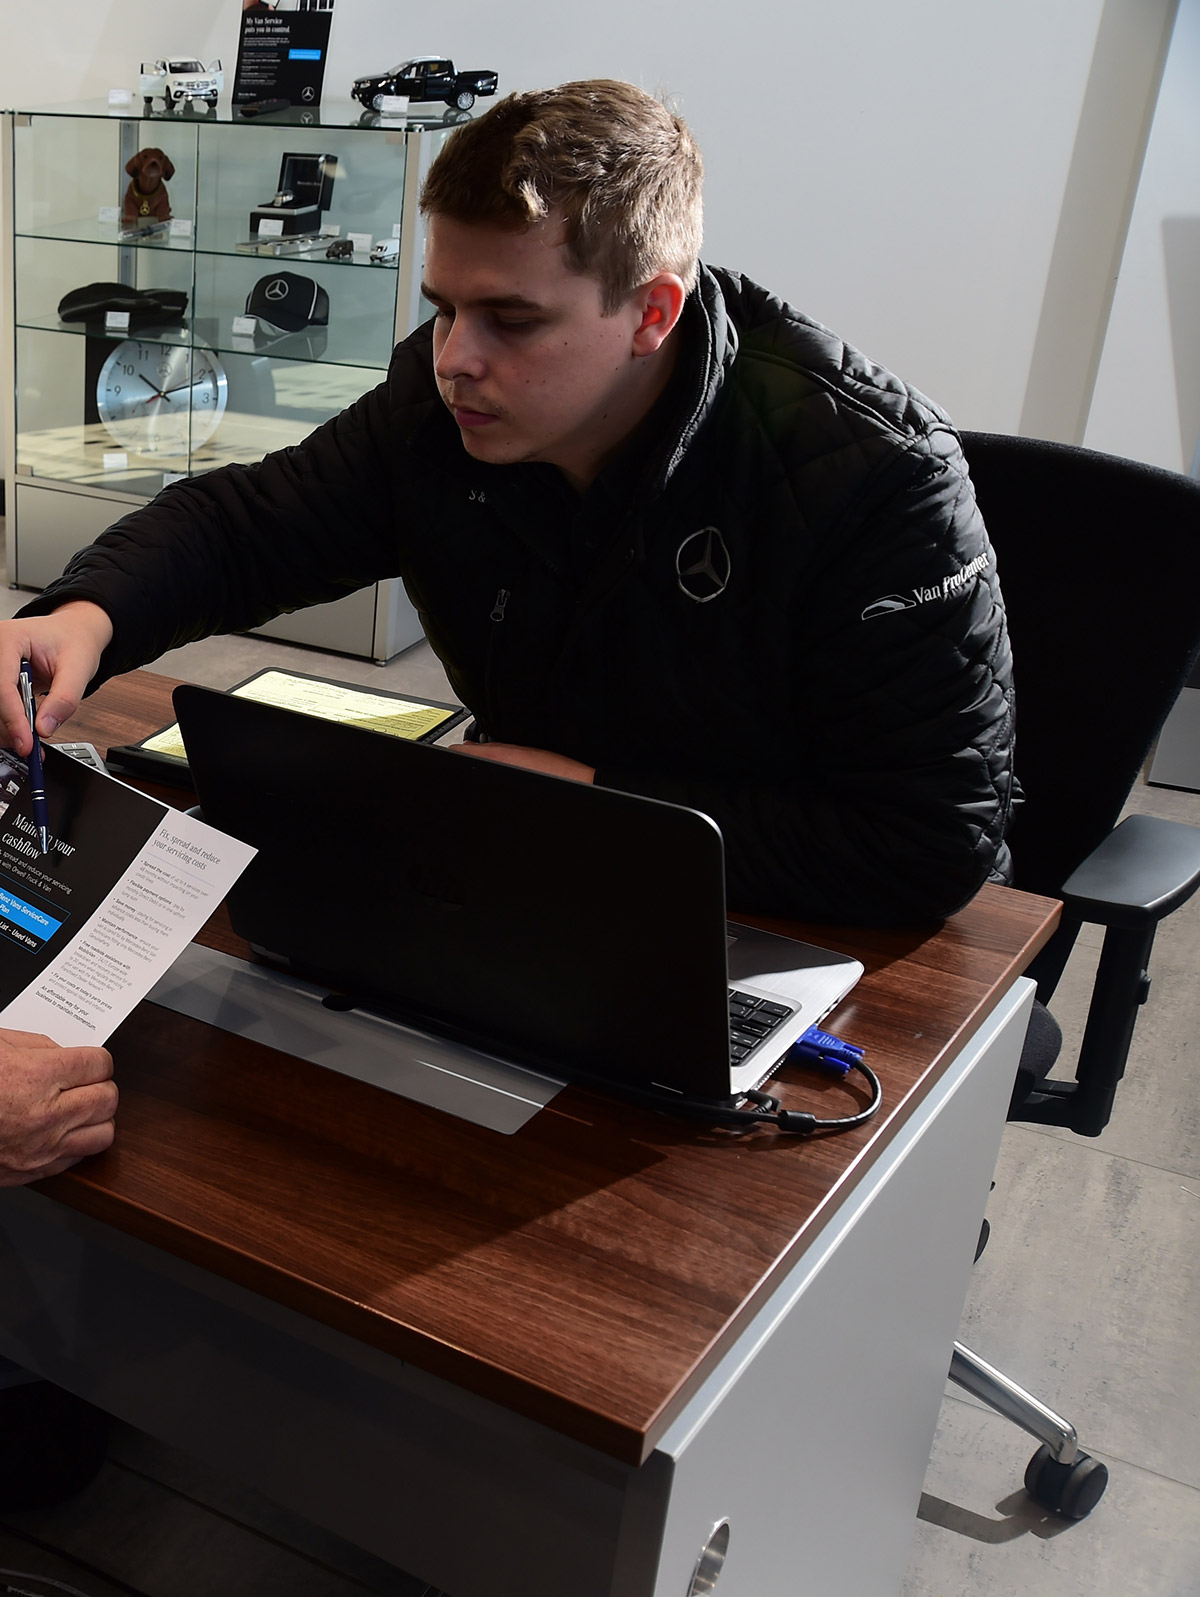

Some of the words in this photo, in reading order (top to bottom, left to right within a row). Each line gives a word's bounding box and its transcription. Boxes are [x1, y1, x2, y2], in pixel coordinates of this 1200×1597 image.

[138, 350, 148, 360] 11
[123, 365, 134, 375] 10
[114, 386, 121, 396] 9
[203, 393, 209, 404] 3
[912, 585, 942, 604] Van
[942, 552, 990, 594] ProCenter
[1, 829, 43, 861] cashflow
[50, 838, 75, 860] your
[152, 838, 167, 851] your
[165, 843, 193, 864] servicing
[191, 857, 208, 870] costs
[158, 828, 172, 841] Fix,
[169, 834, 191, 851] spread
[188, 843, 202, 855] and
[199, 849, 221, 865] reduce
[1, 850, 19, 864] spread
[17, 858, 28, 868] and
[26, 863, 42, 876] reduce
[40, 873, 52, 883] your
[50, 878, 72, 895] servicing
[1, 860, 12, 869] with
[10, 865, 26, 877] Orwell
[25, 873, 38, 884] Truck
[41, 883, 52, 892] Van
[9, 899, 22, 910] Vans
[20, 905, 49, 926] ServiceCare
[123, 904, 136, 912] money
[11, 928, 25, 940] Used
[24, 936, 37, 947] Vans
[35, 989, 53, 1003] business
[56, 1002, 74, 1016] maintain
[73, 1013, 97, 1030] momentum.
[46, 988, 66, 1002] affordable
[64, 1000, 73, 1008] way
[77, 1008, 88, 1017] your
